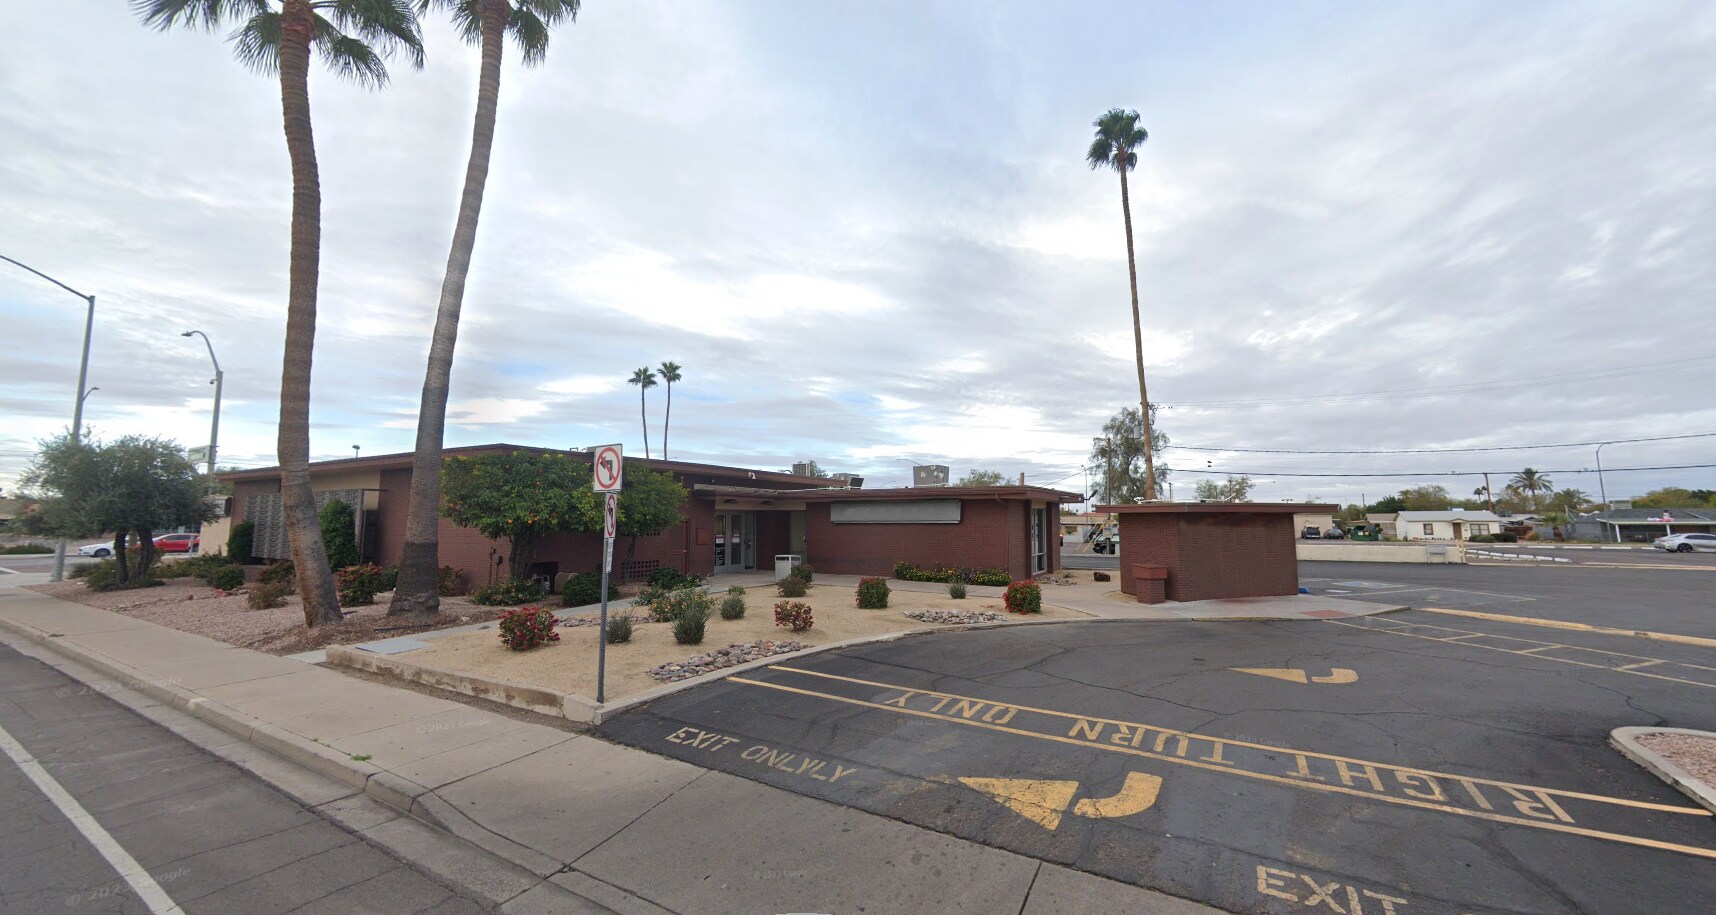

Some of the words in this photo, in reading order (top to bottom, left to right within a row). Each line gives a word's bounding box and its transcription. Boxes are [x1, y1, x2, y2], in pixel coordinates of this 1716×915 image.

[882, 691, 1019, 724] ONLY
[665, 727, 740, 752] EXIT
[740, 745, 858, 783] ONLYLY
[1068, 719, 1234, 766] TURN
[1286, 754, 1576, 823] RIGHT
[1257, 865, 1408, 915] EXIT
